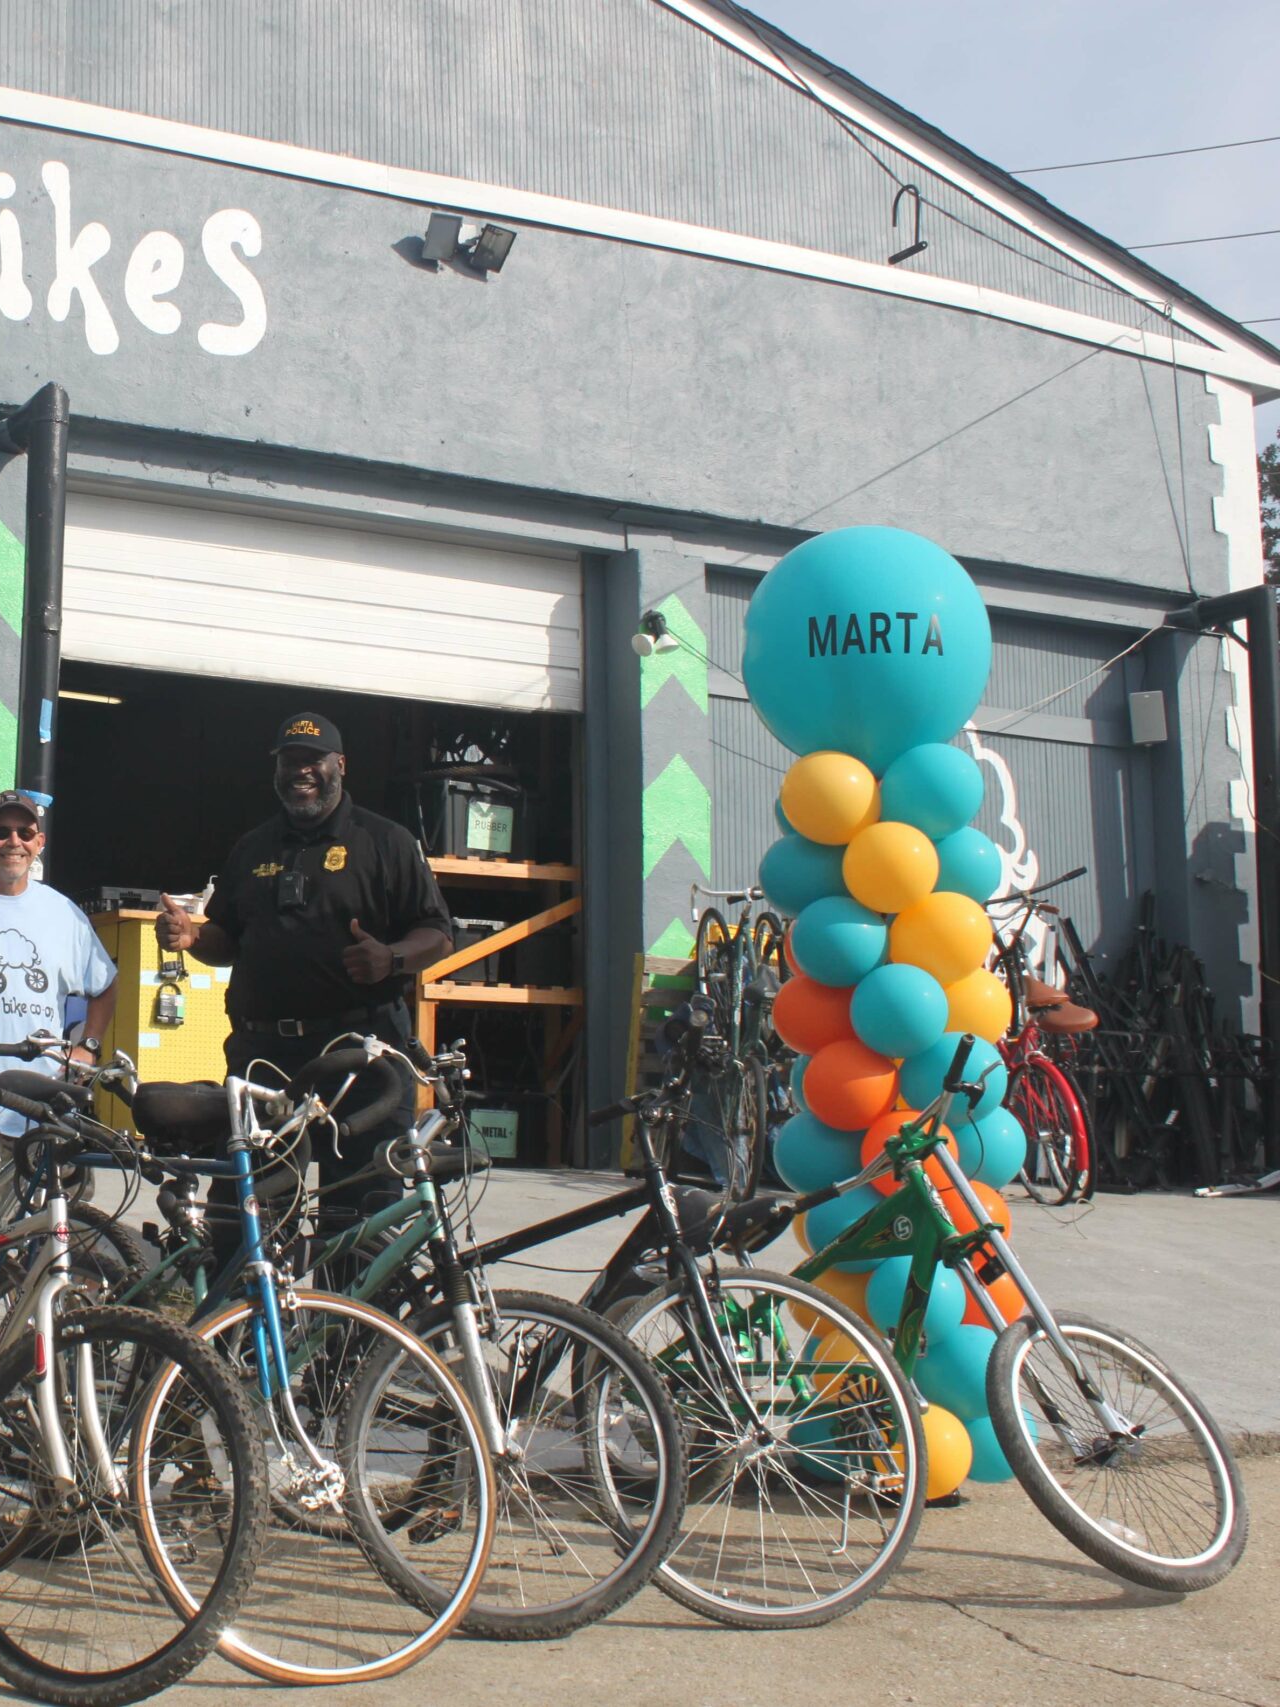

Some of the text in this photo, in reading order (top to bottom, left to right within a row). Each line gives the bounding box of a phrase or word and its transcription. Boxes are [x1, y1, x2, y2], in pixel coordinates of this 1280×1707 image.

[807, 612, 945, 658] MARTA
[284, 727, 321, 736] POLICE
[474, 819, 508, 833] RUBBER
[1, 996, 28, 1018] bike
[481, 1126, 508, 1139] METAL
